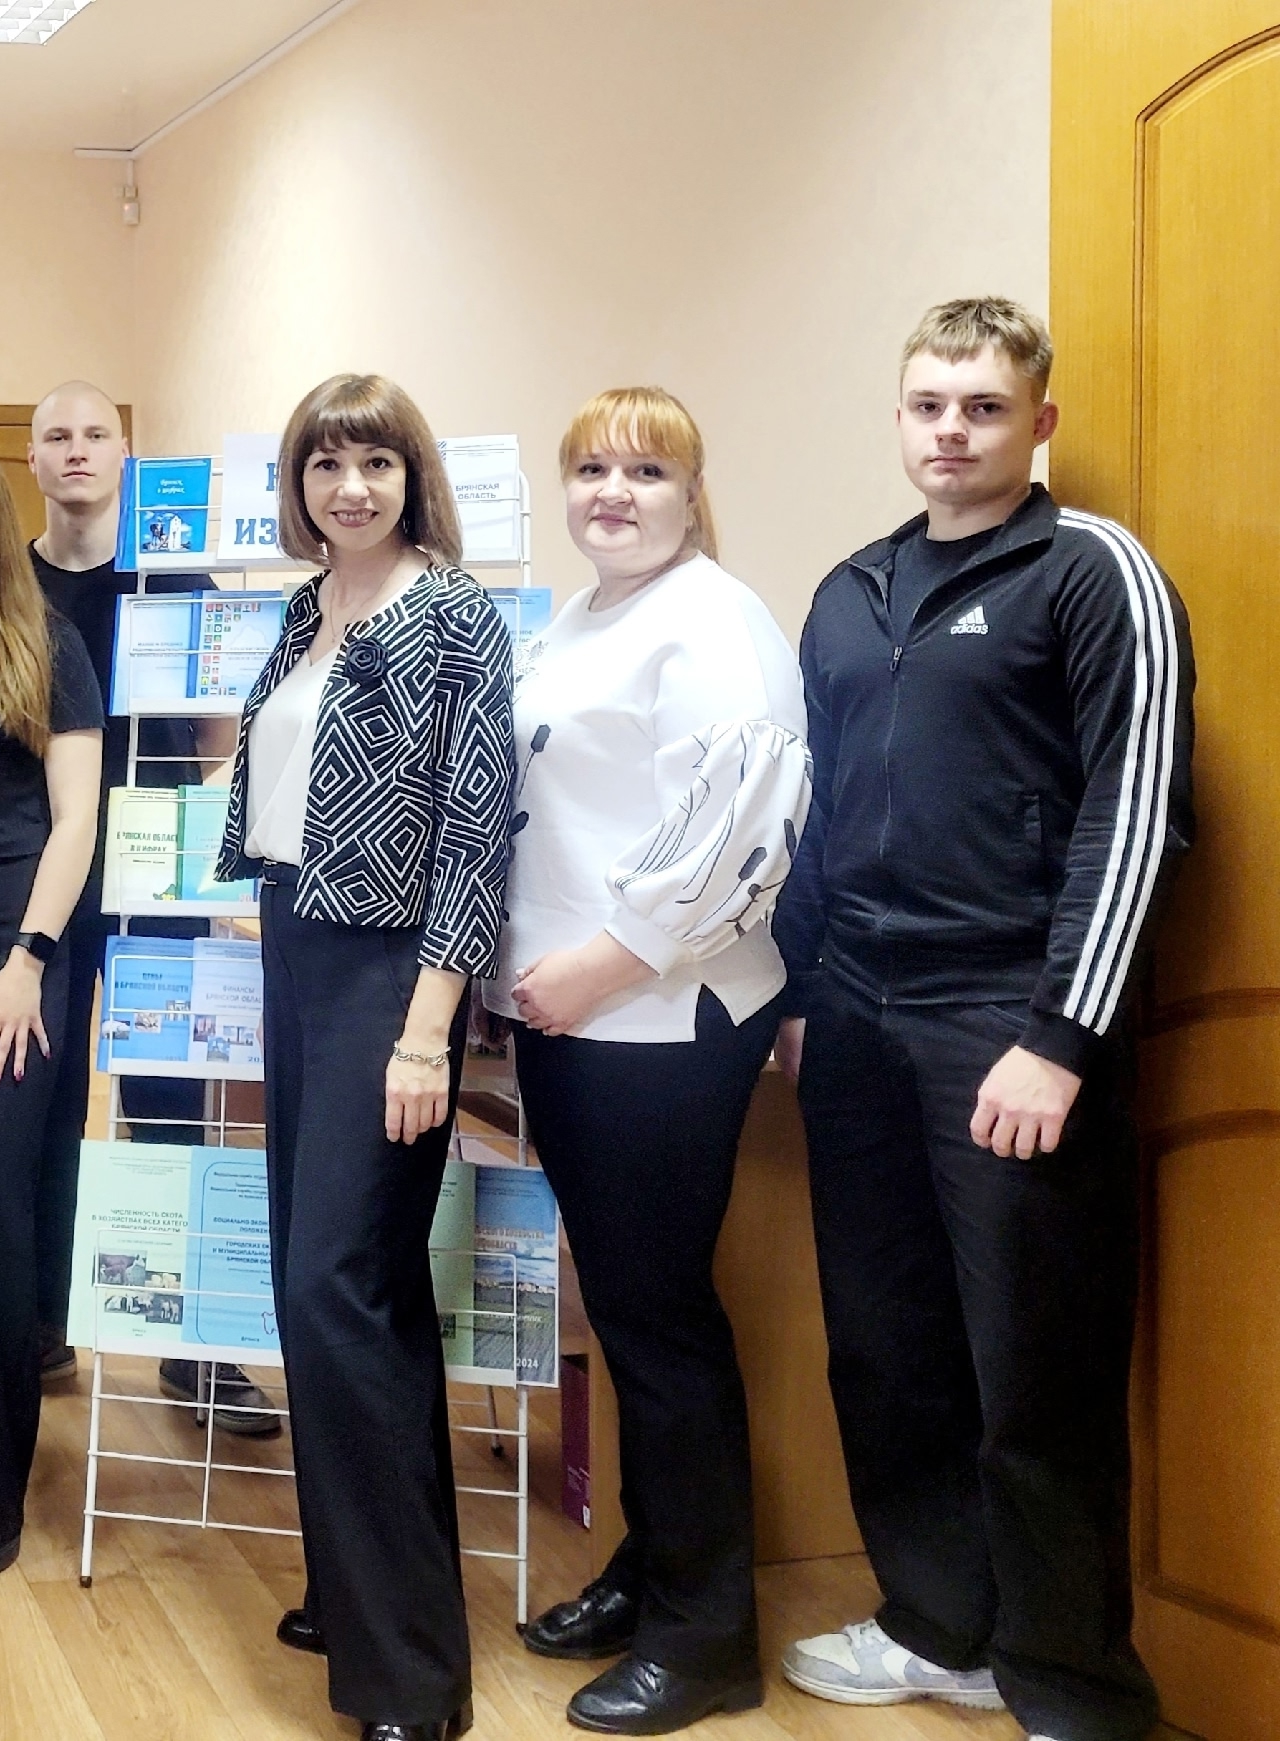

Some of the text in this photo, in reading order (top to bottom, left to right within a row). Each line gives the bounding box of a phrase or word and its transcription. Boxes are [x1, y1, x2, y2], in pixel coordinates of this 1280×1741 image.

[455, 483, 500, 492] БРЯНСКАЯ
[457, 492, 497, 500] ОБЛАСТЬ
[950, 624, 990, 635] adidas
[110, 1208, 183, 1219] ЧИСЛЕННОСТЬ СКОТА
[516, 1358, 539, 1369] 2024
